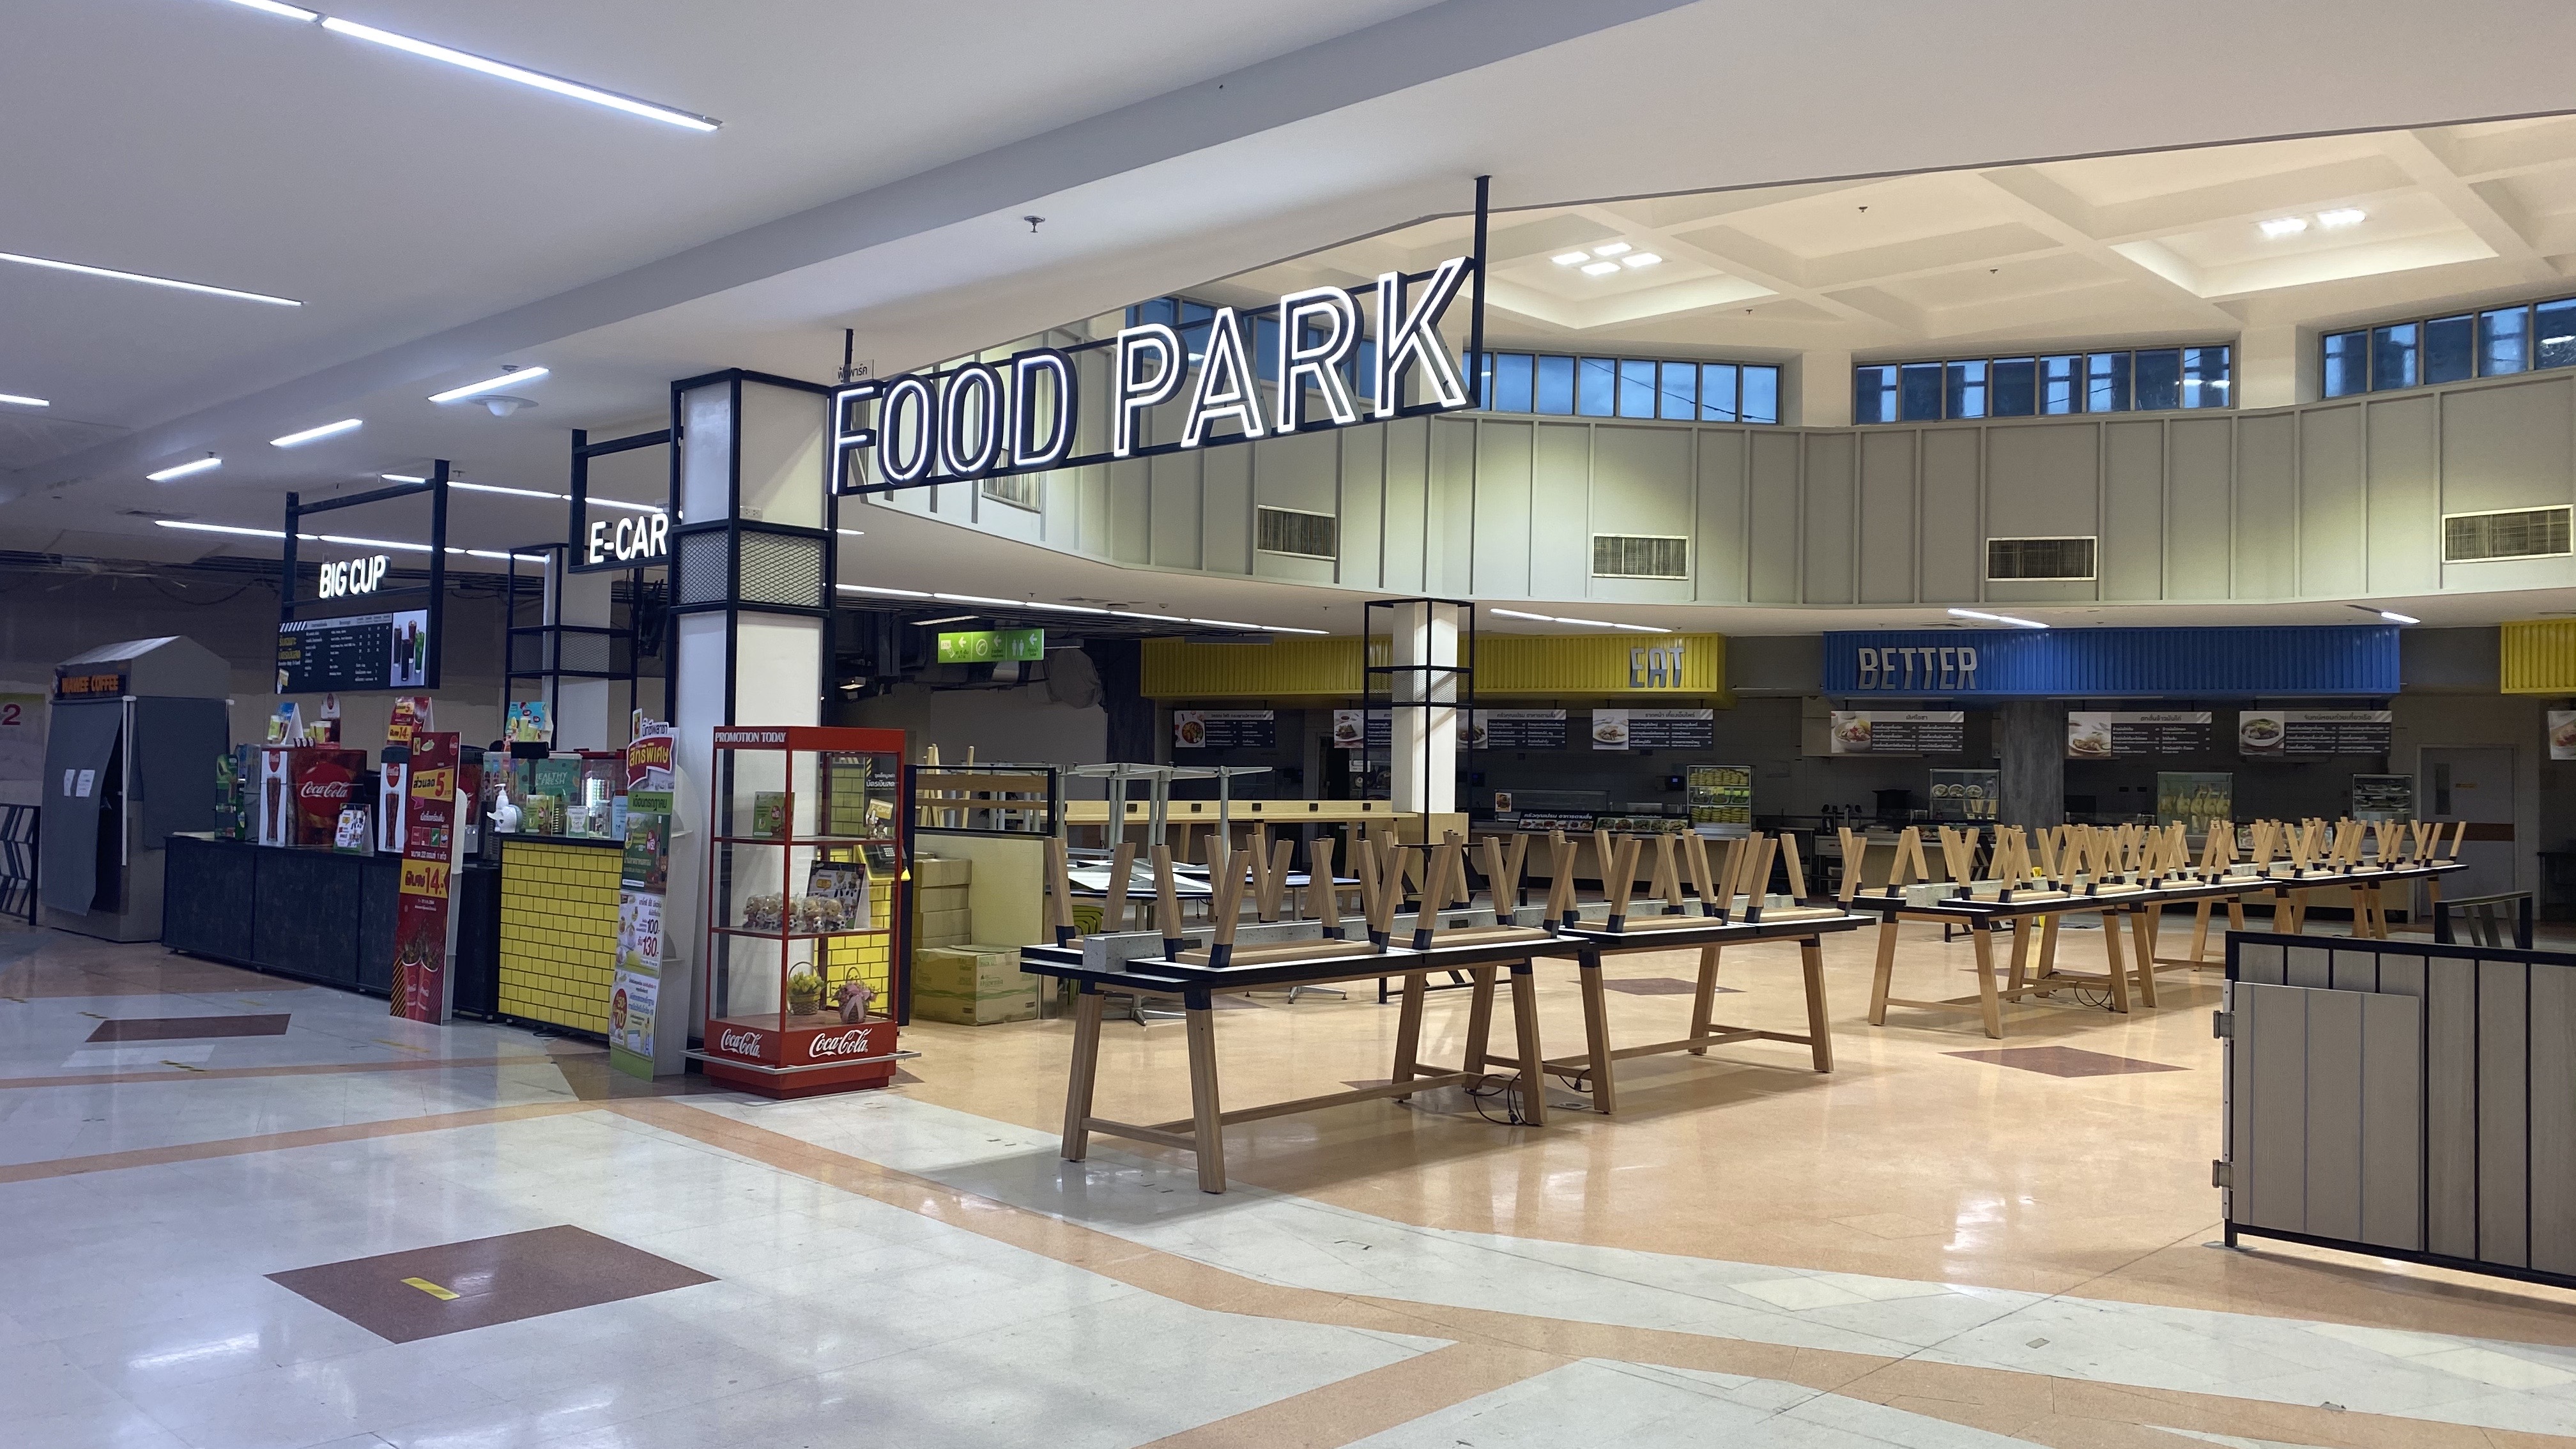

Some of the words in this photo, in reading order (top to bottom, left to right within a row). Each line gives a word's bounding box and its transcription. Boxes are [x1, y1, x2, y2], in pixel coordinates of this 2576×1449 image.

[827, 347, 1078, 496] FOOD
[1114, 256, 1469, 457] PARK
[590, 513, 668, 563] E-CAR
[319, 561, 347, 599] BIG
[349, 555, 386, 595] CUP
[1630, 647, 1684, 687] EAT
[1858, 647, 1977, 690] BETTER
[91, 674, 118, 691] COFFEE
[3, 703, 21, 725] 2
[715, 732, 760, 742] PROMOTION
[761, 732, 786, 742] TODAY
[629, 742, 669, 767] สิทธิพิเศษ
[300, 781, 349, 798] Coca-Cola
[413, 776, 434, 789] ส่วนลด
[435, 772, 445, 797] 5
[721, 1028, 763, 1057] Coca-Cola
[809, 1028, 873, 1058] Coca-Cola
